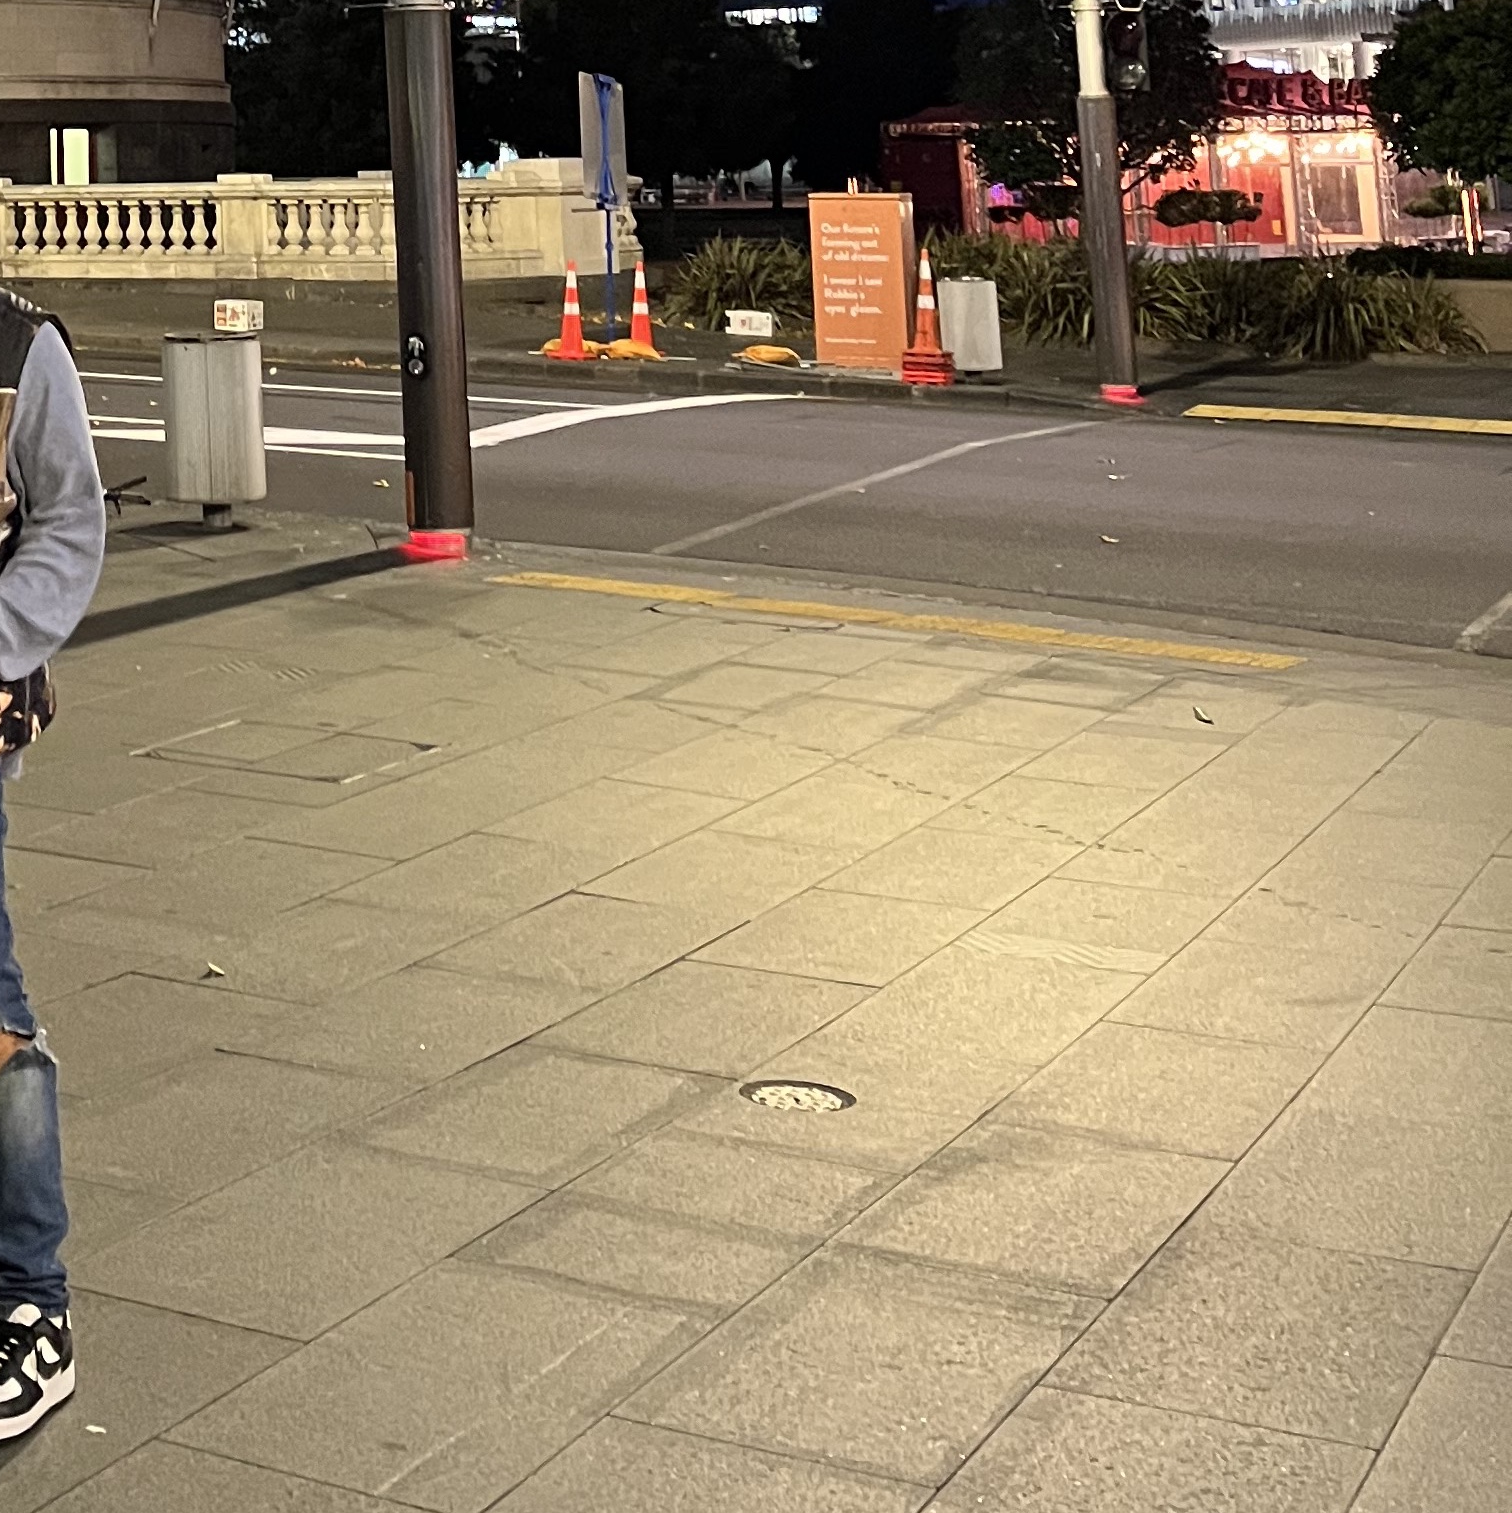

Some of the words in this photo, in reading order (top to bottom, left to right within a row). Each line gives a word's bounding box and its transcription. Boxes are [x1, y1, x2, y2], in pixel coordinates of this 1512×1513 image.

[1329, 78, 1368, 106] BA
[821, 222, 841, 234] Our
[834, 249, 850, 261] old
